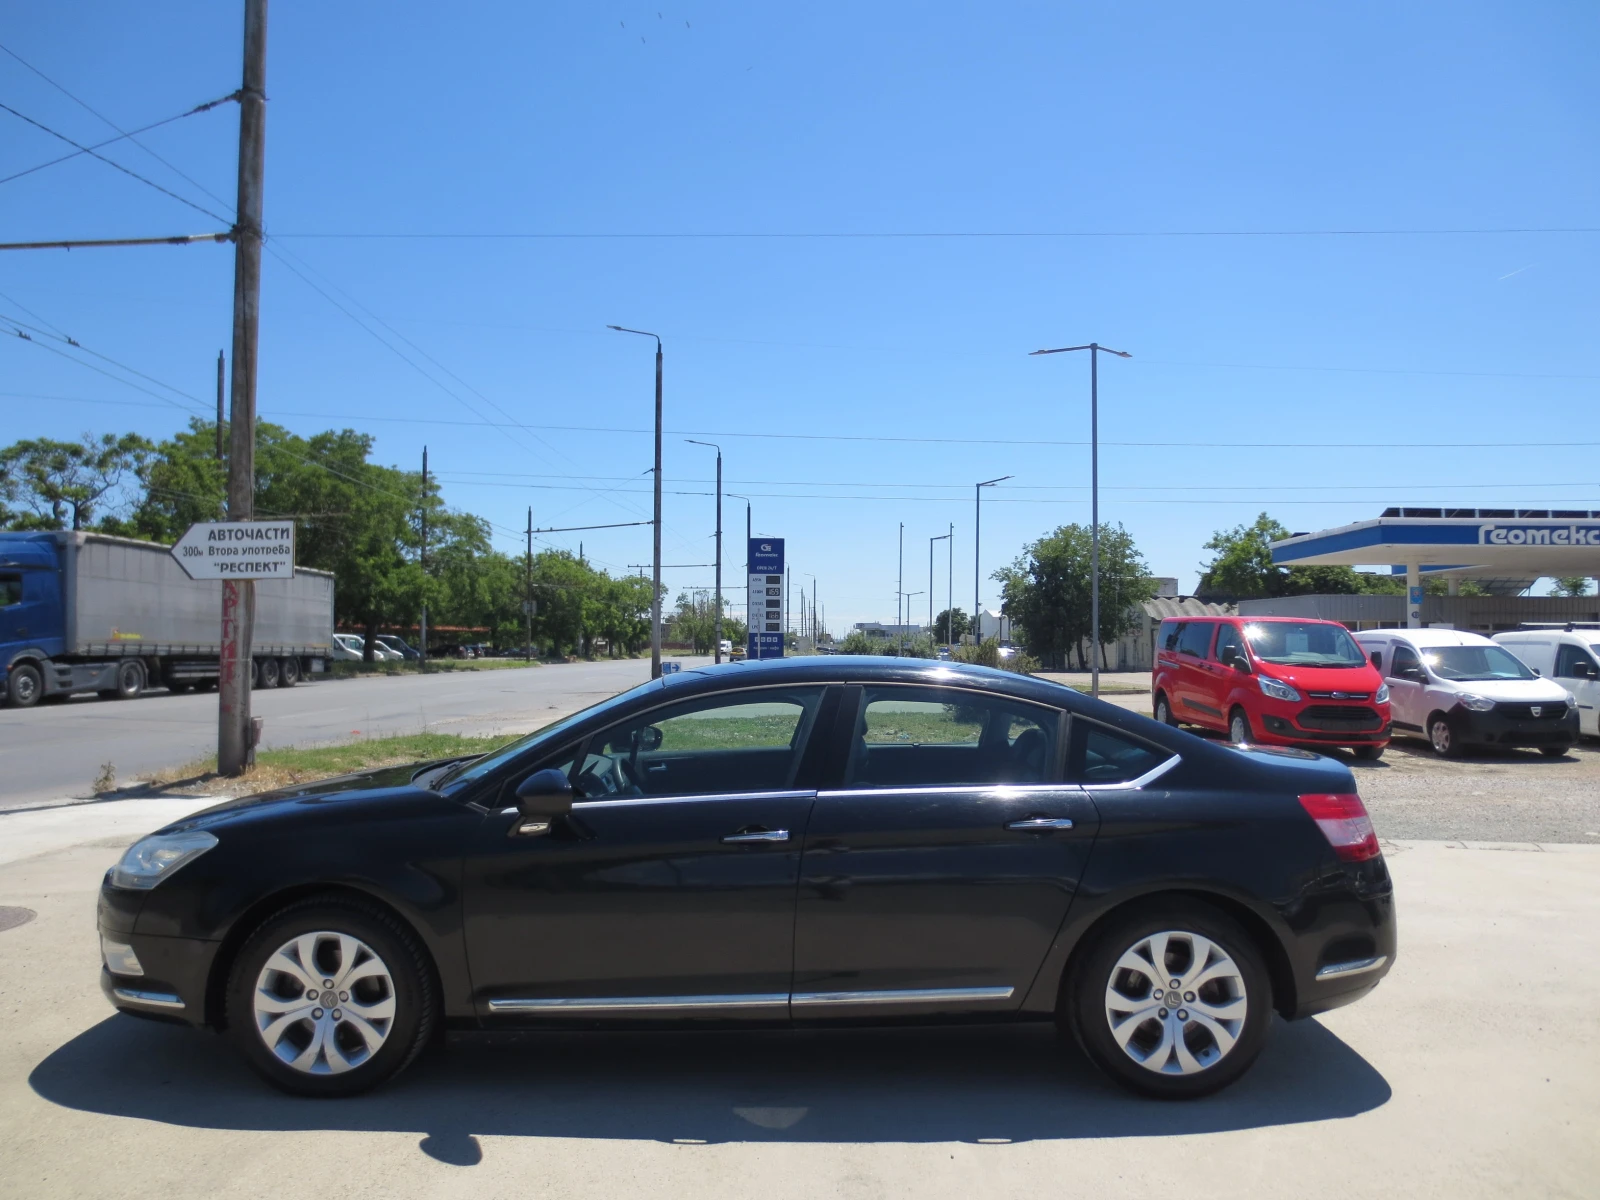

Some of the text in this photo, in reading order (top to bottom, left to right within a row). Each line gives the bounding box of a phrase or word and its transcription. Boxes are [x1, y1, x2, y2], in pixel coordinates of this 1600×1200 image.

[208, 527, 290, 541] АВТОЧАСТИ
[208, 546, 239, 556] Втора
[242, 544, 290, 556] употреба
[213, 561, 286, 573] "РЕСПЕКТ"
